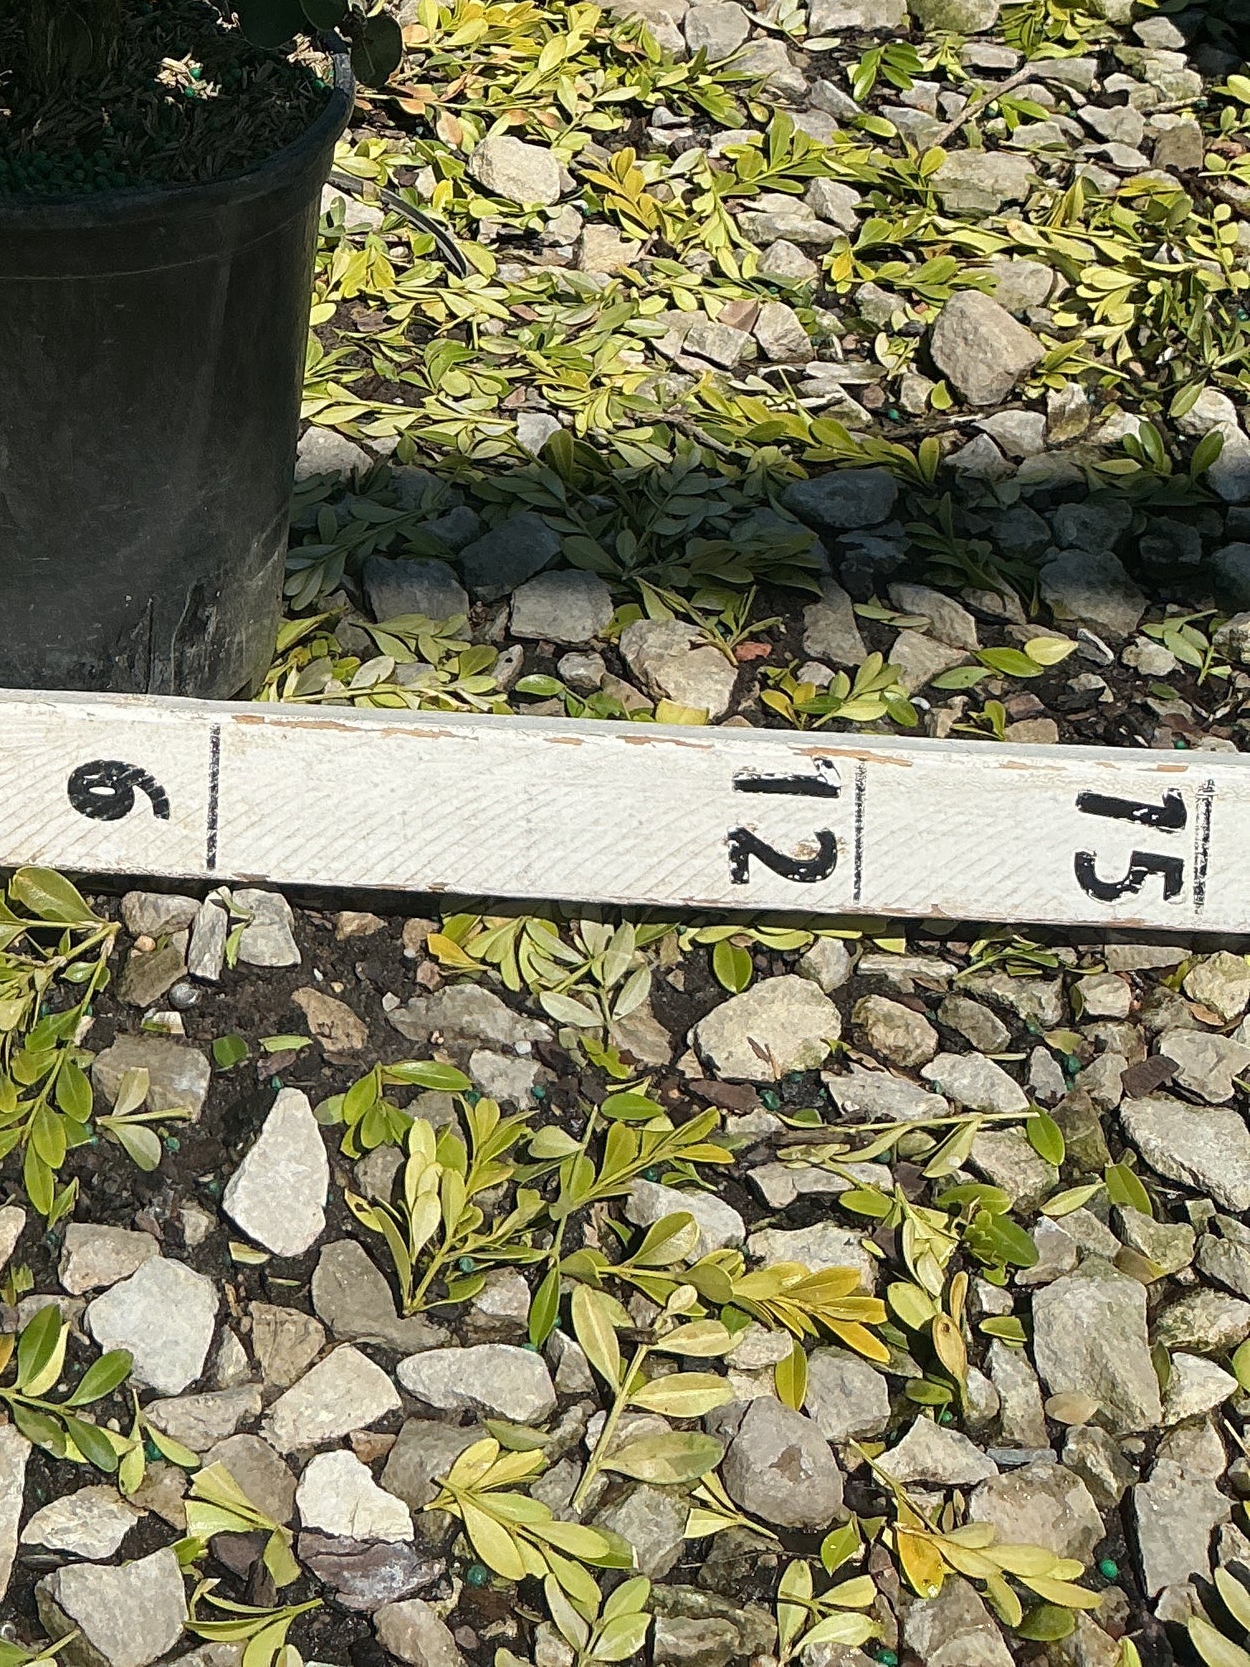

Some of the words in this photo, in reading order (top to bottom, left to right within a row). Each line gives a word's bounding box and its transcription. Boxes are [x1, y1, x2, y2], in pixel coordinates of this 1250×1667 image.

[67, 759, 171, 821] 6
[727, 756, 843, 885] 12
[1074, 787, 1188, 904] 15
